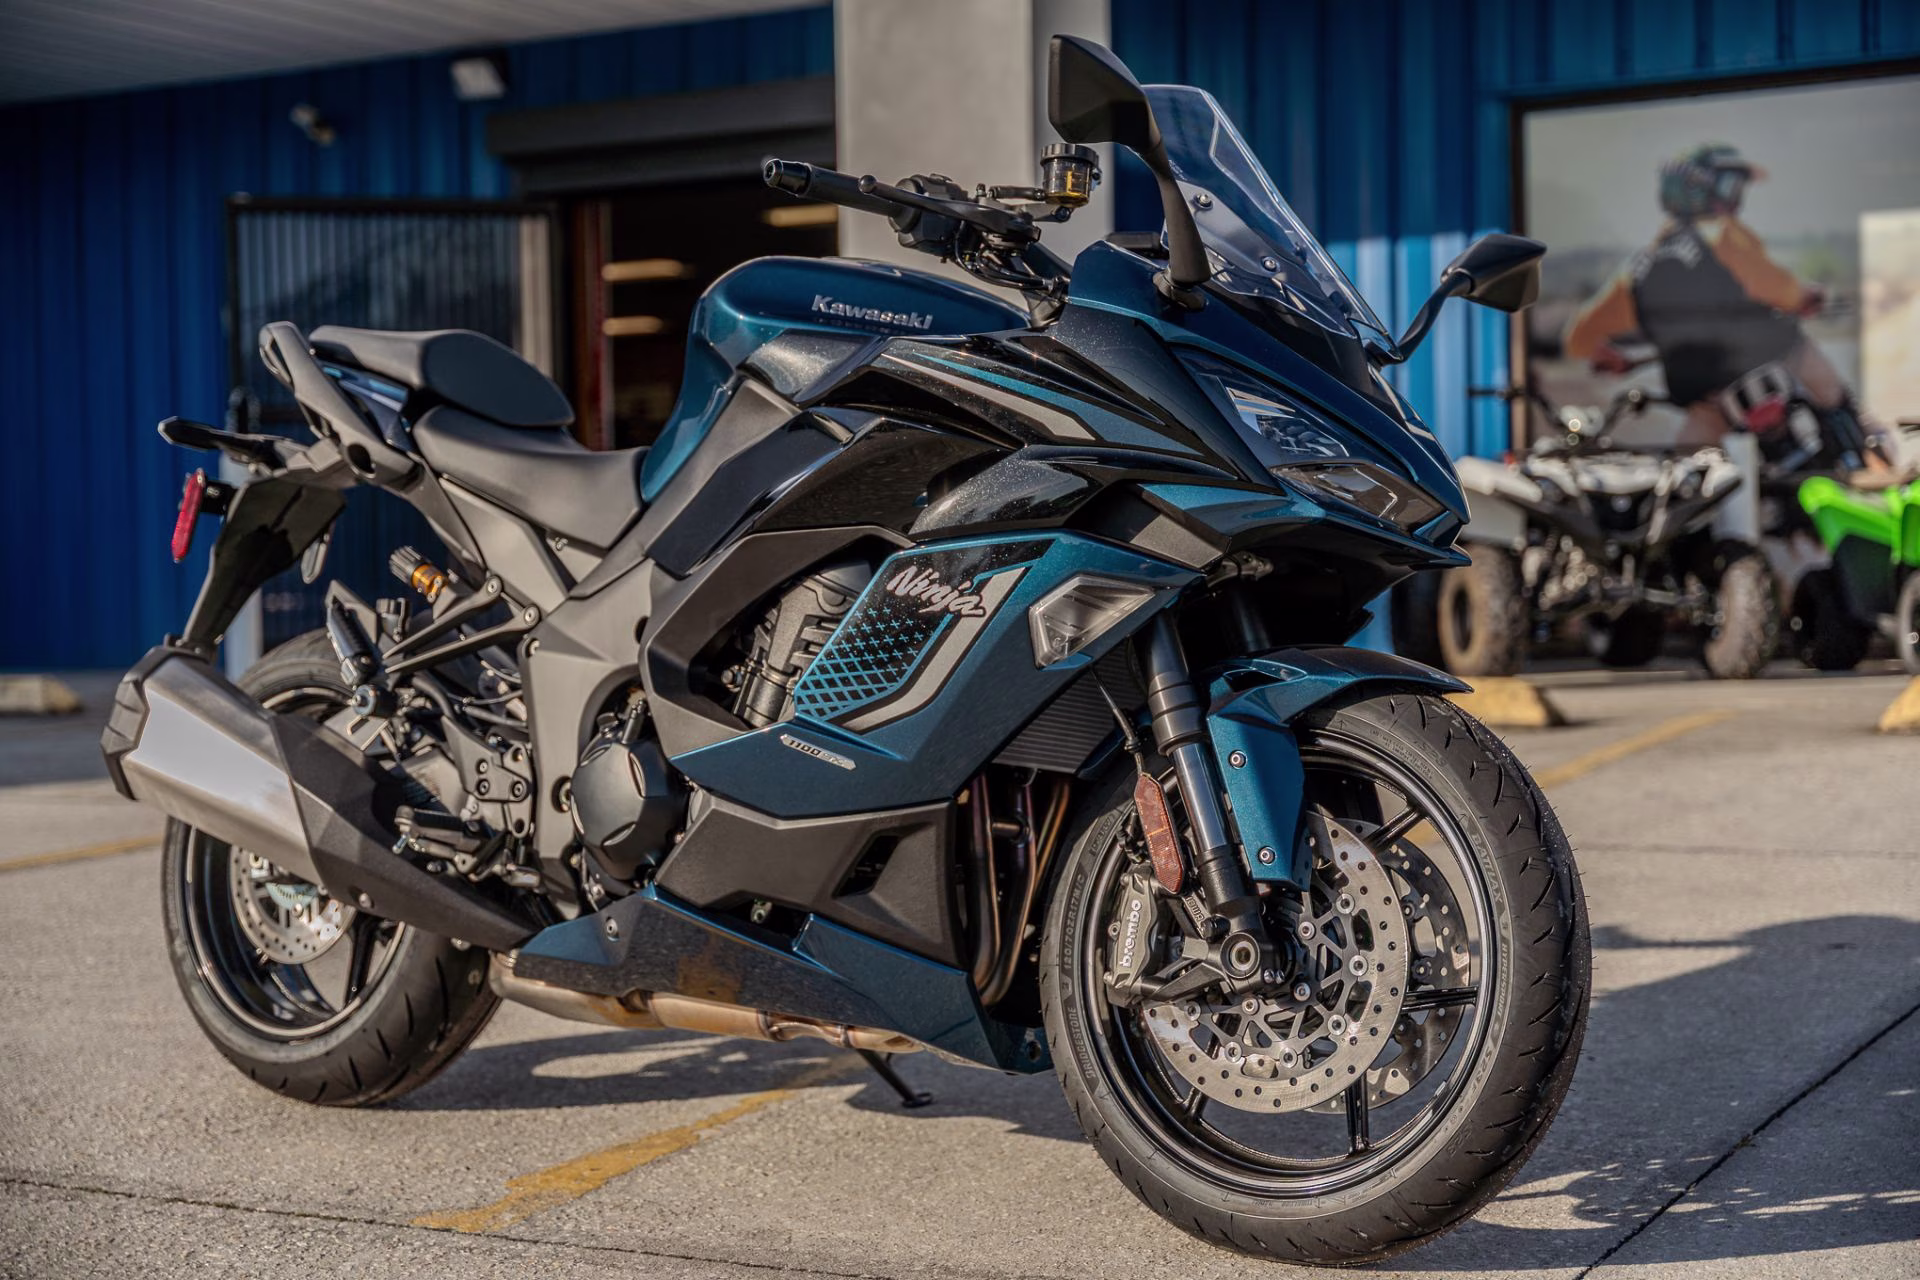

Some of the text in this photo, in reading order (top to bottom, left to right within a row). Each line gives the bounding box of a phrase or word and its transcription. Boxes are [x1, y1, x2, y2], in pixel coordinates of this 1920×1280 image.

[811, 294, 933, 330] Kawasaki
[886, 565, 984, 615] Ninja
[1471, 834, 1502, 903] BATTLAX
[1120, 900, 1141, 967] brembo
[1067, 1007, 1096, 1079] BRIDGESTONE
